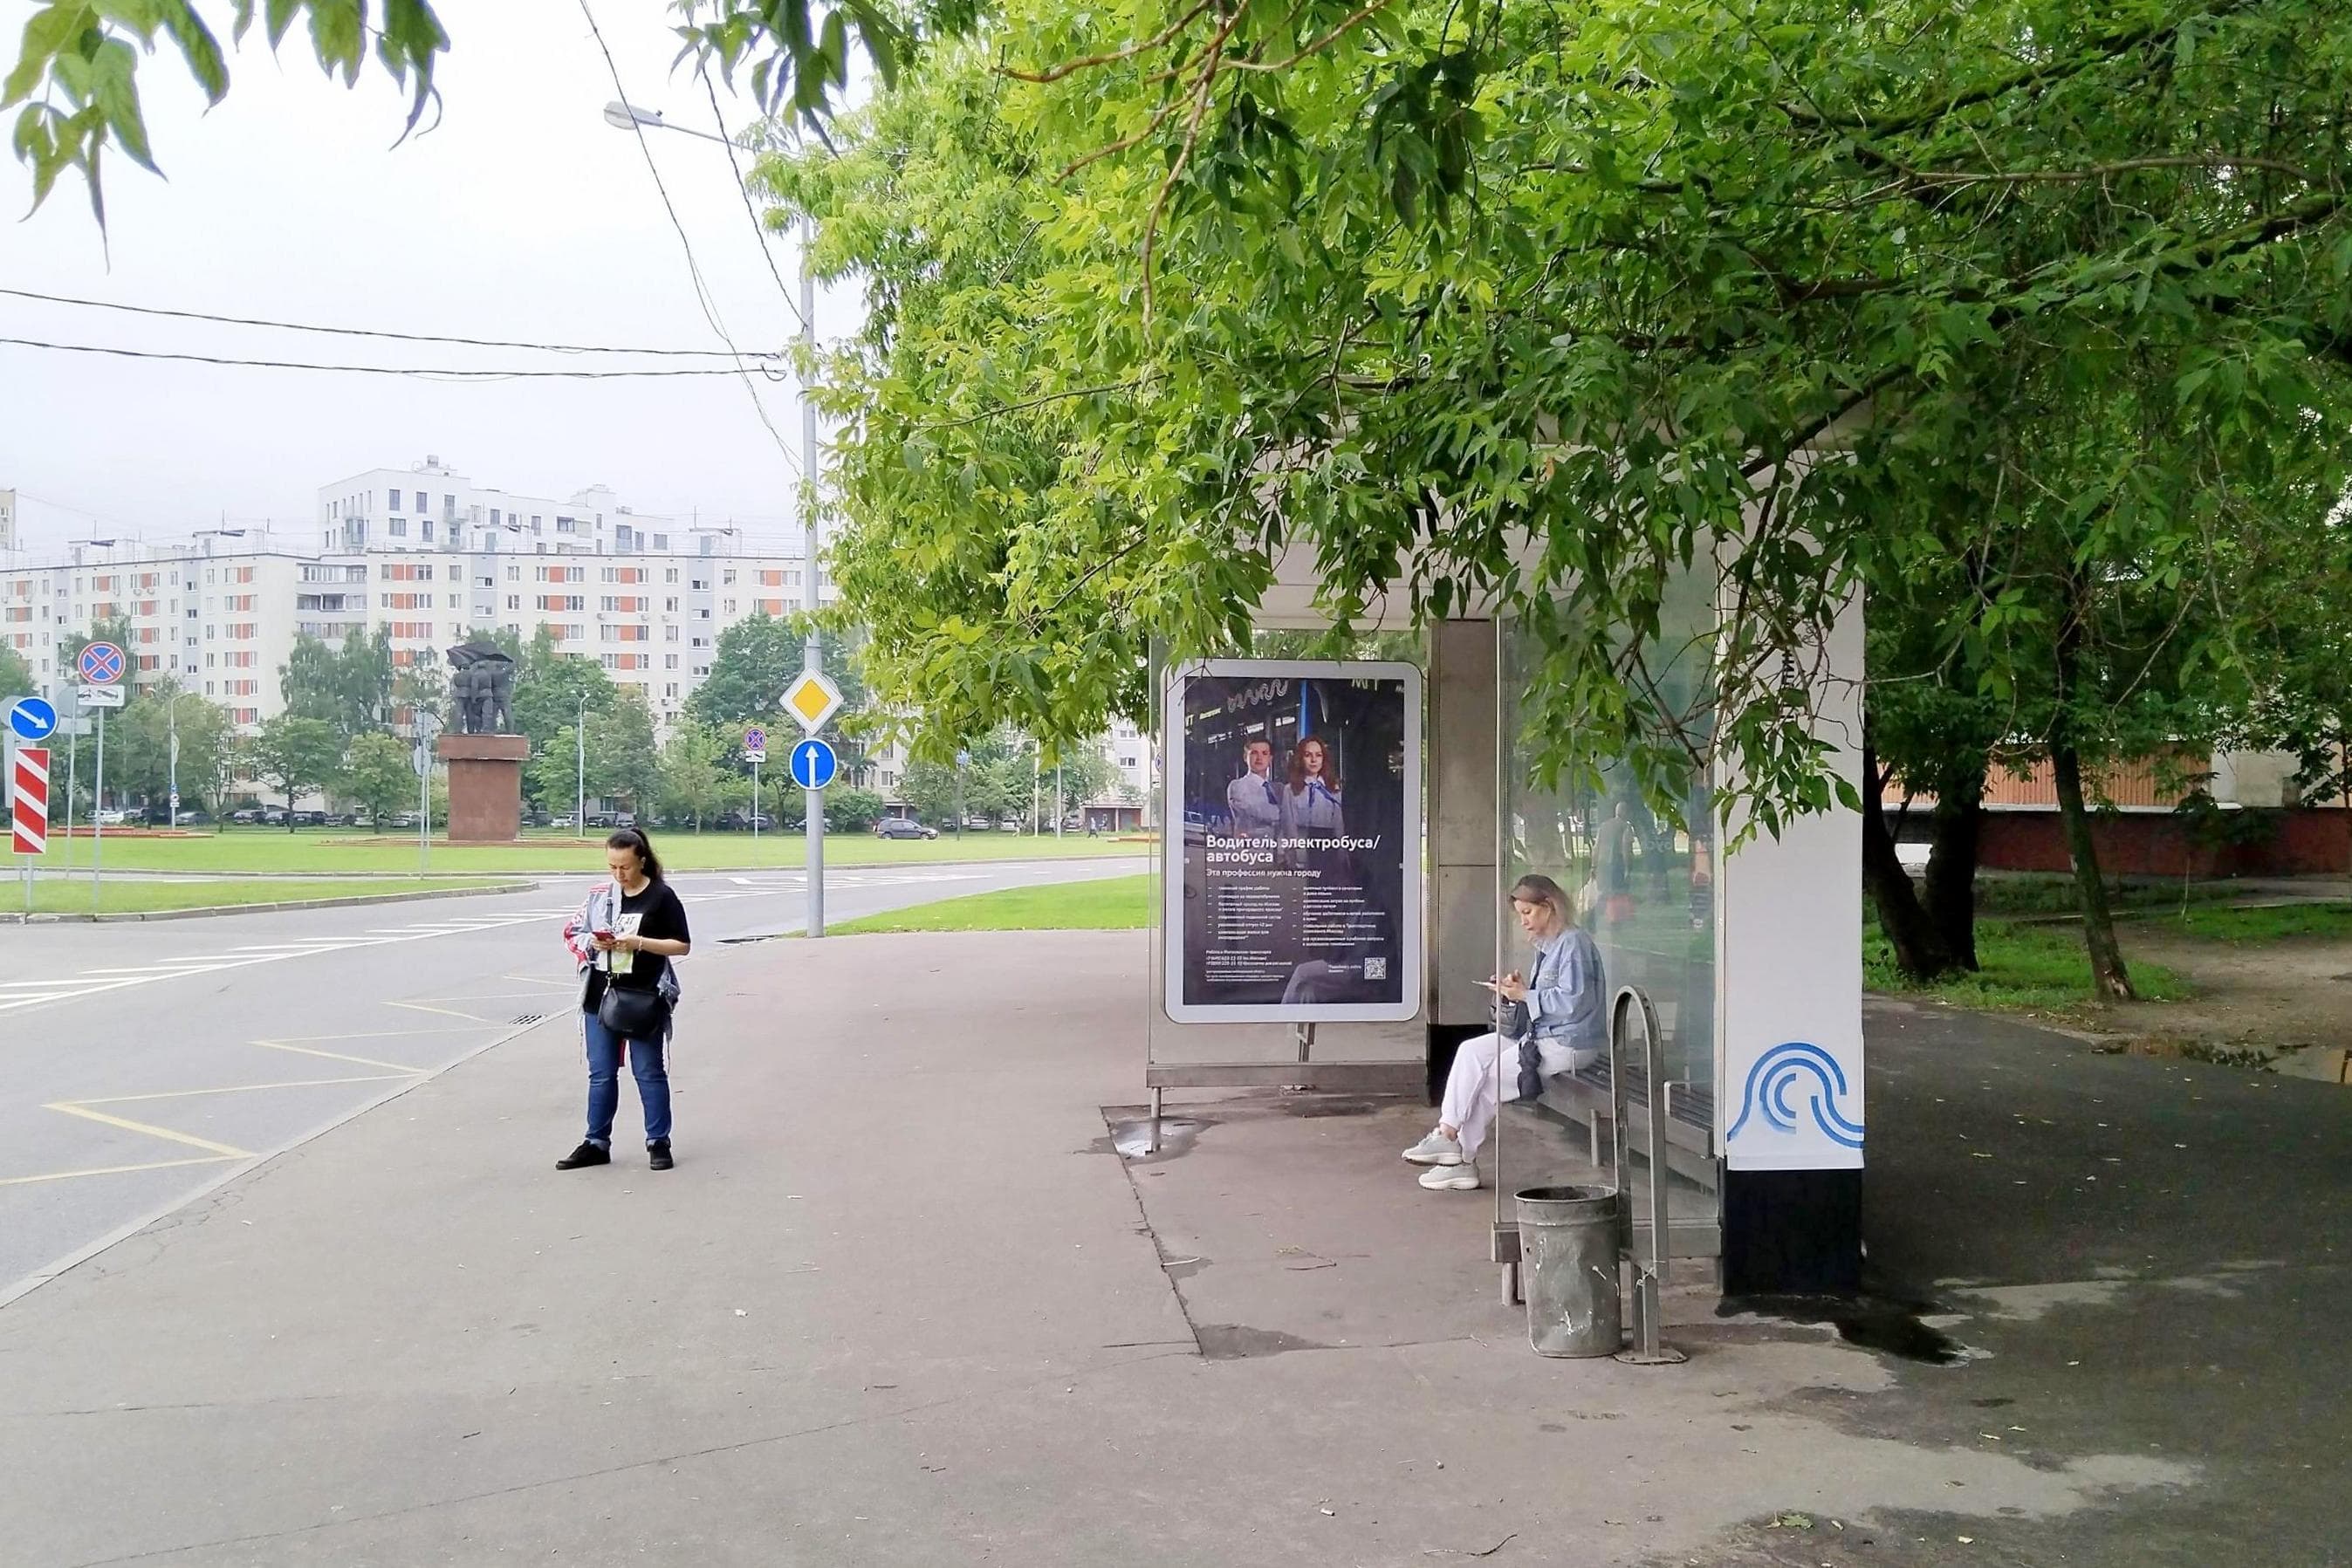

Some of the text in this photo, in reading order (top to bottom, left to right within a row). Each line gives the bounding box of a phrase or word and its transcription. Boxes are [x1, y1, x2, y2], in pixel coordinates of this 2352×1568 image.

[1206, 835, 1381, 851] Водитель электробуса/
[1206, 849, 1274, 865] автобуса
[1206, 868, 1220, 877] Эта
[1222, 869, 1265, 878] профессия
[1294, 869, 1322, 879] городу
